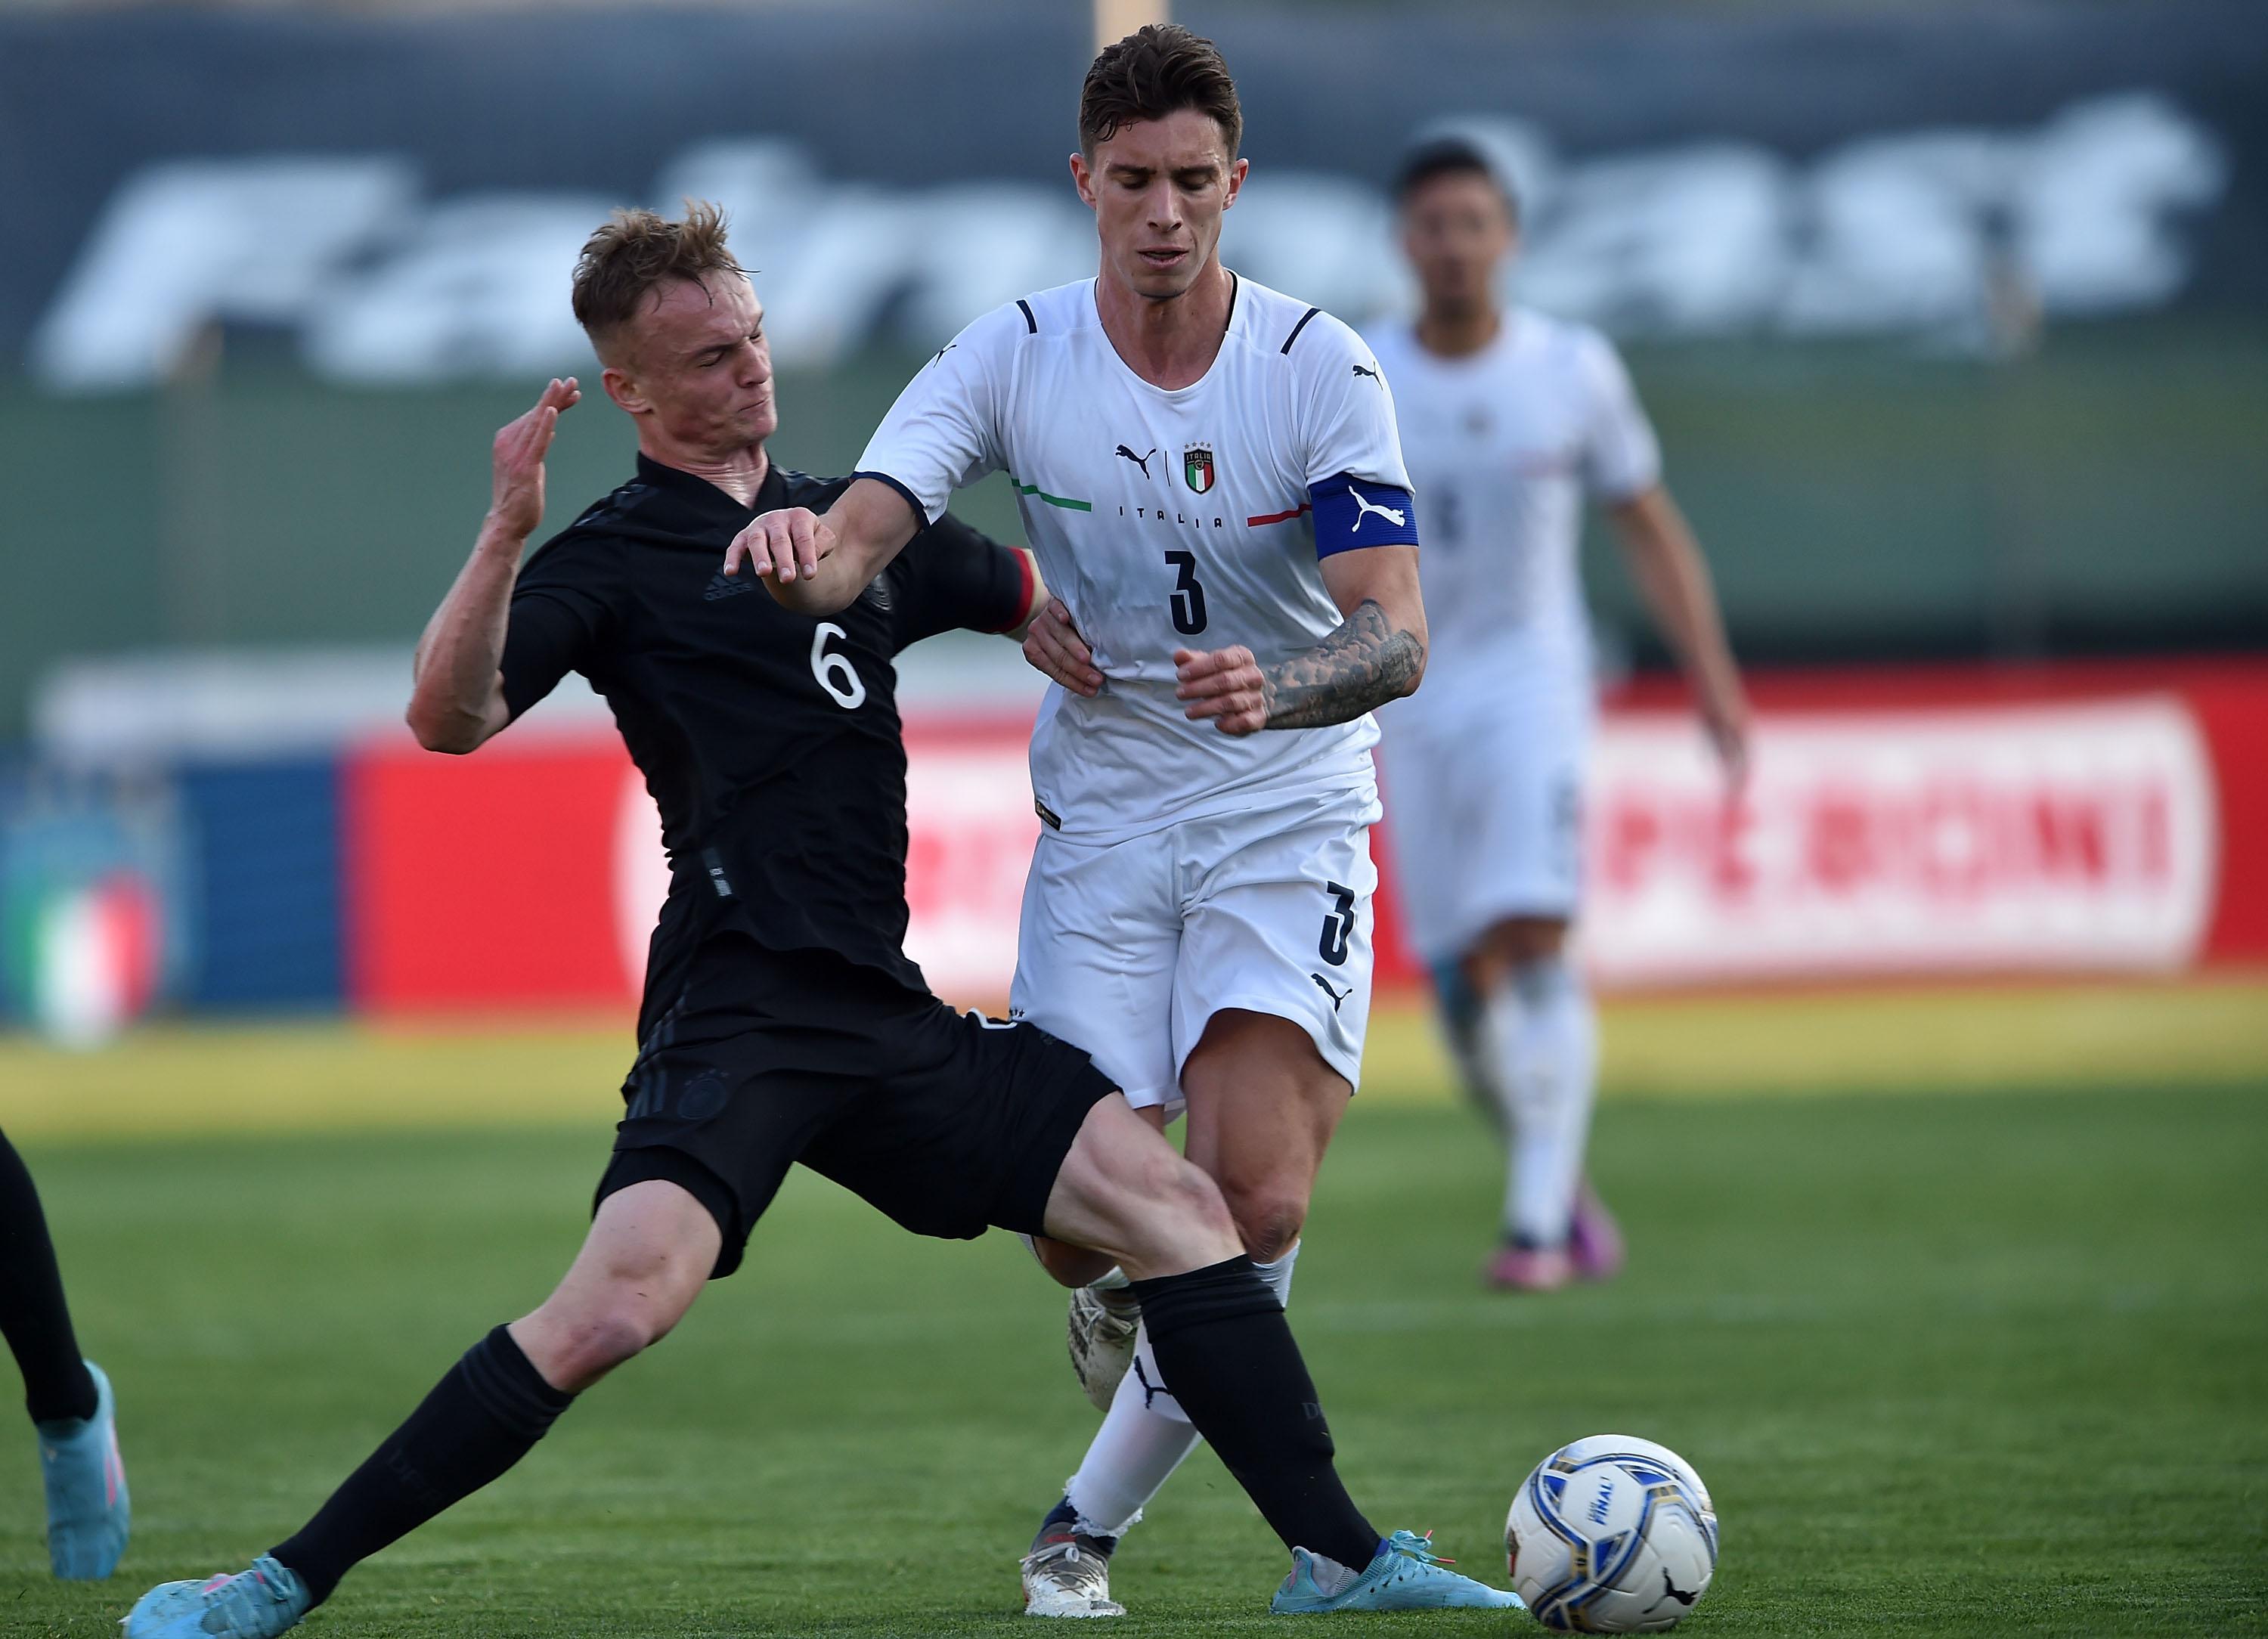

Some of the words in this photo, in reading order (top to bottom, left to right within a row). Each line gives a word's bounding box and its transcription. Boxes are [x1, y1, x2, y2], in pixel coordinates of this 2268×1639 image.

[1186, 452, 1211, 461] ITALIA
[1119, 505, 1222, 529] ITALIA
[1164, 550, 1208, 636] 3
[810, 622, 866, 709] 6
[1318, 880, 1355, 966] 3
